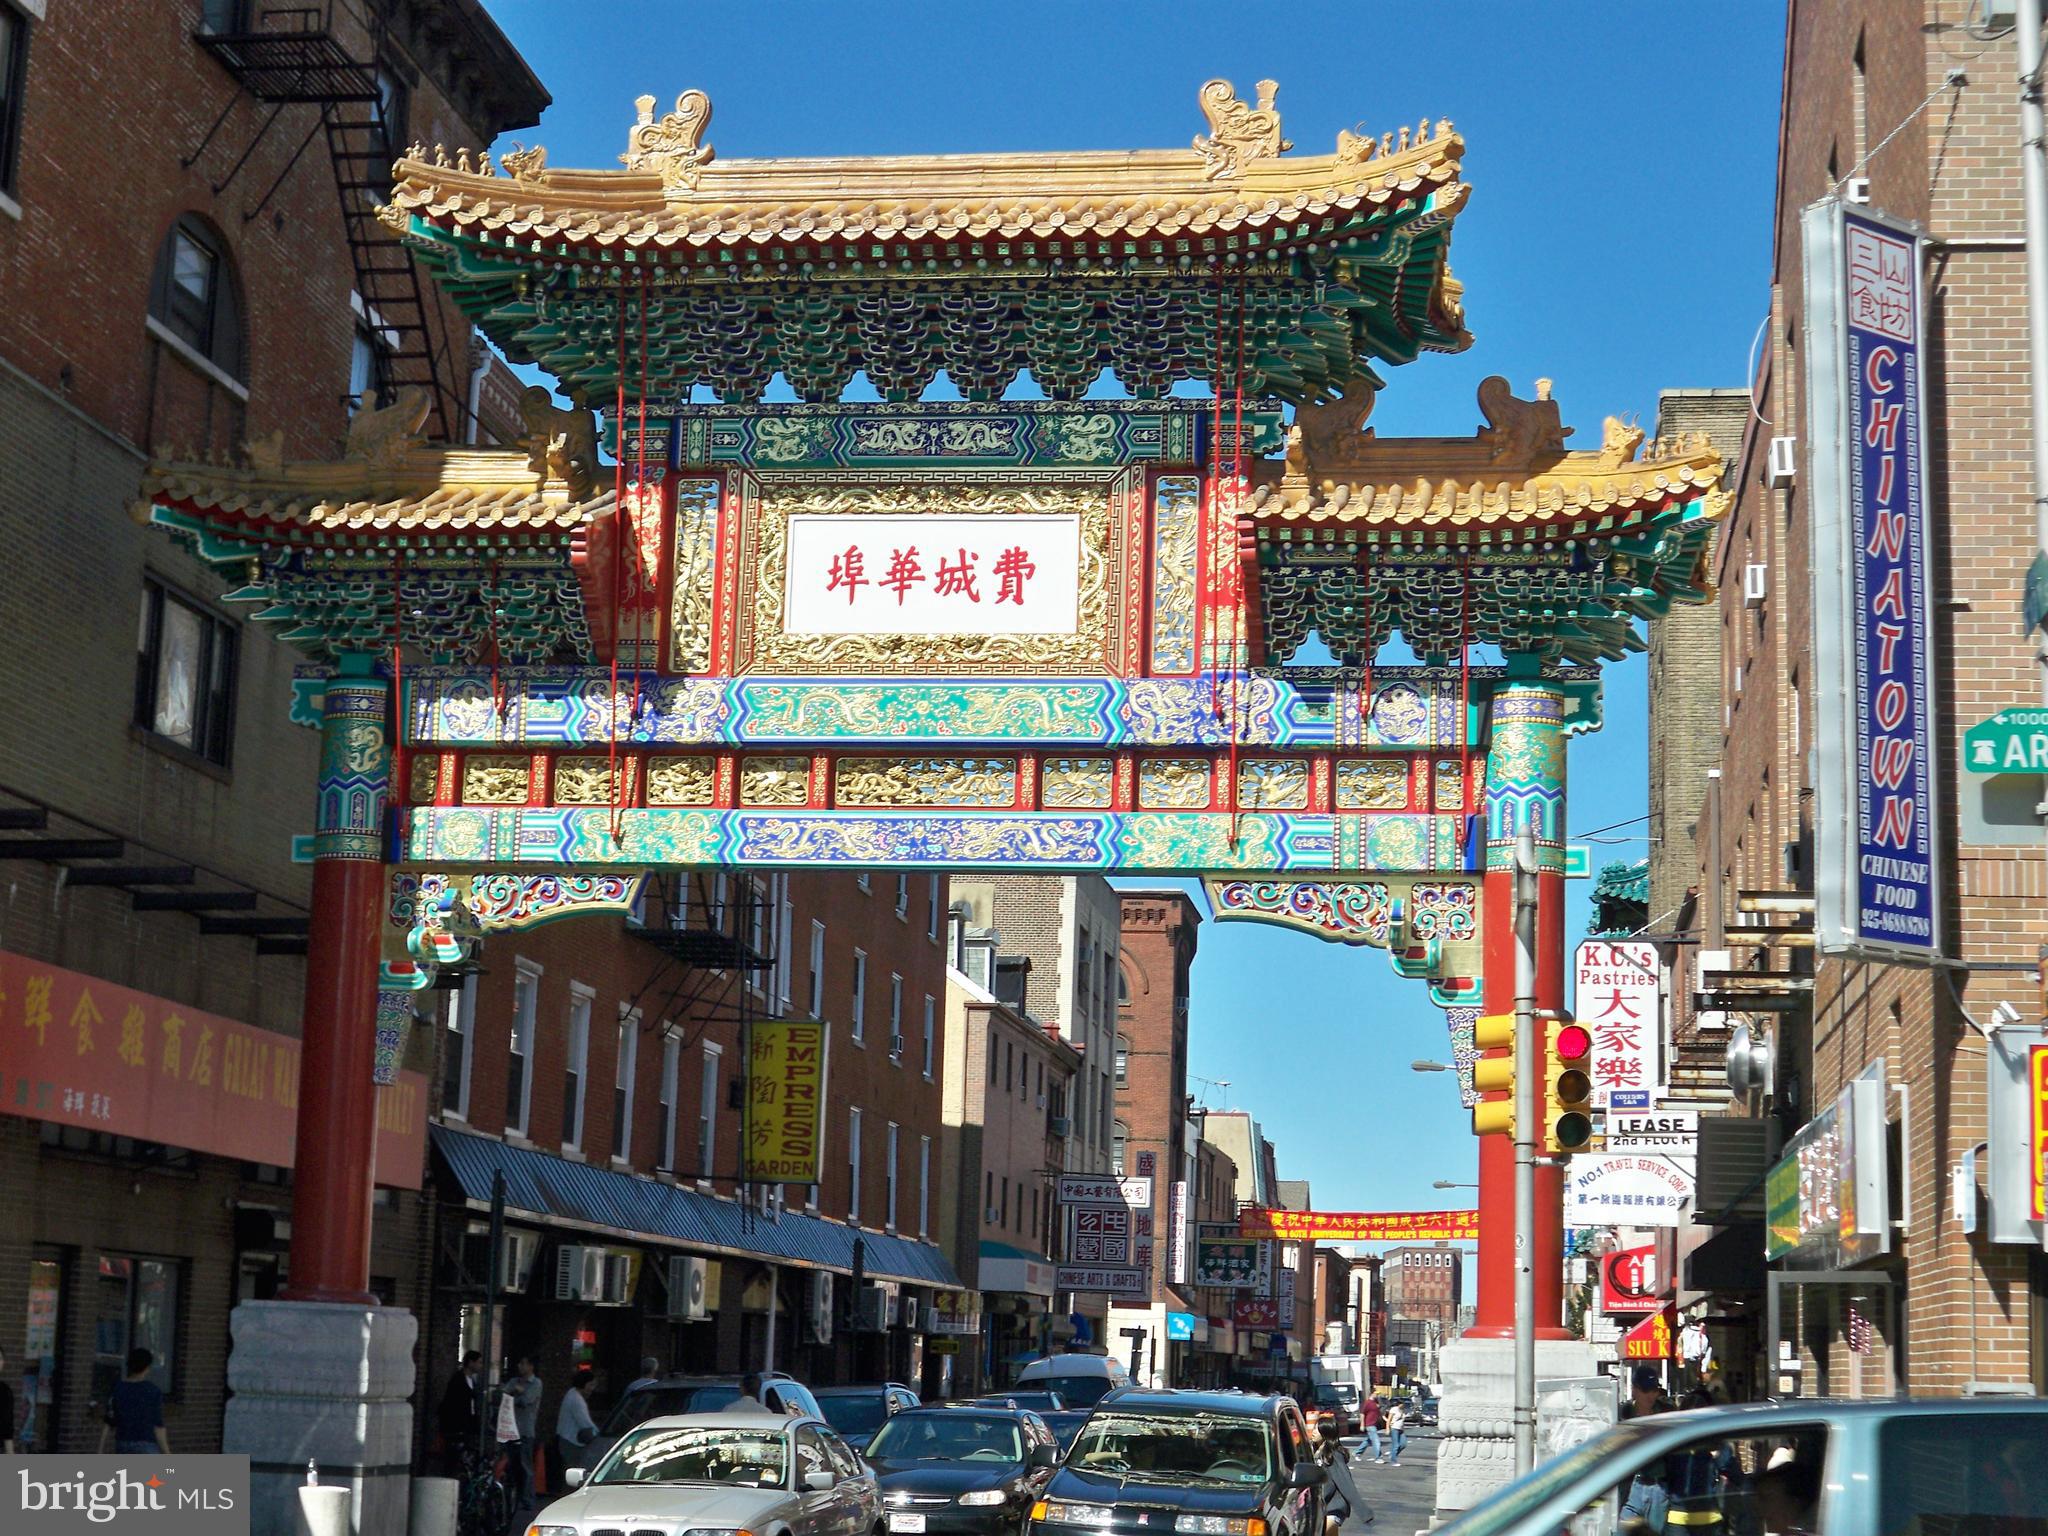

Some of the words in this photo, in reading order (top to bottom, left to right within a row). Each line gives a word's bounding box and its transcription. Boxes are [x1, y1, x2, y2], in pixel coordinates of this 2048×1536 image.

[1866, 345, 1914, 850] CHINATOWN
[1861, 854, 1928, 884] CHINESE
[1874, 883, 1917, 909] FOOD
[1580, 970, 1656, 986] Pastries
[1594, 988, 1643, 1088] 大家樂
[781, 1027, 818, 1158] EMPRESS
[1618, 1118, 1685, 1133] LEASE
[1612, 1136, 1638, 1146] 2nd
[745, 1160, 814, 1176] GARDEN
[1603, 1158, 1633, 1174] TRAVEL
[1637, 1158, 1670, 1179] SERVICE
[1369, 1231, 1383, 1239] THE
[1385, 1230, 1417, 1239] PEOPLE'S
[1419, 1230, 1451, 1238] REPUBLIC
[1453, 1230, 1463, 1238] OF
[1060, 1272, 1084, 1286] CHINESE
[1087, 1272, 1104, 1286] ARTS
[1628, 1341, 1651, 1356] SIU
